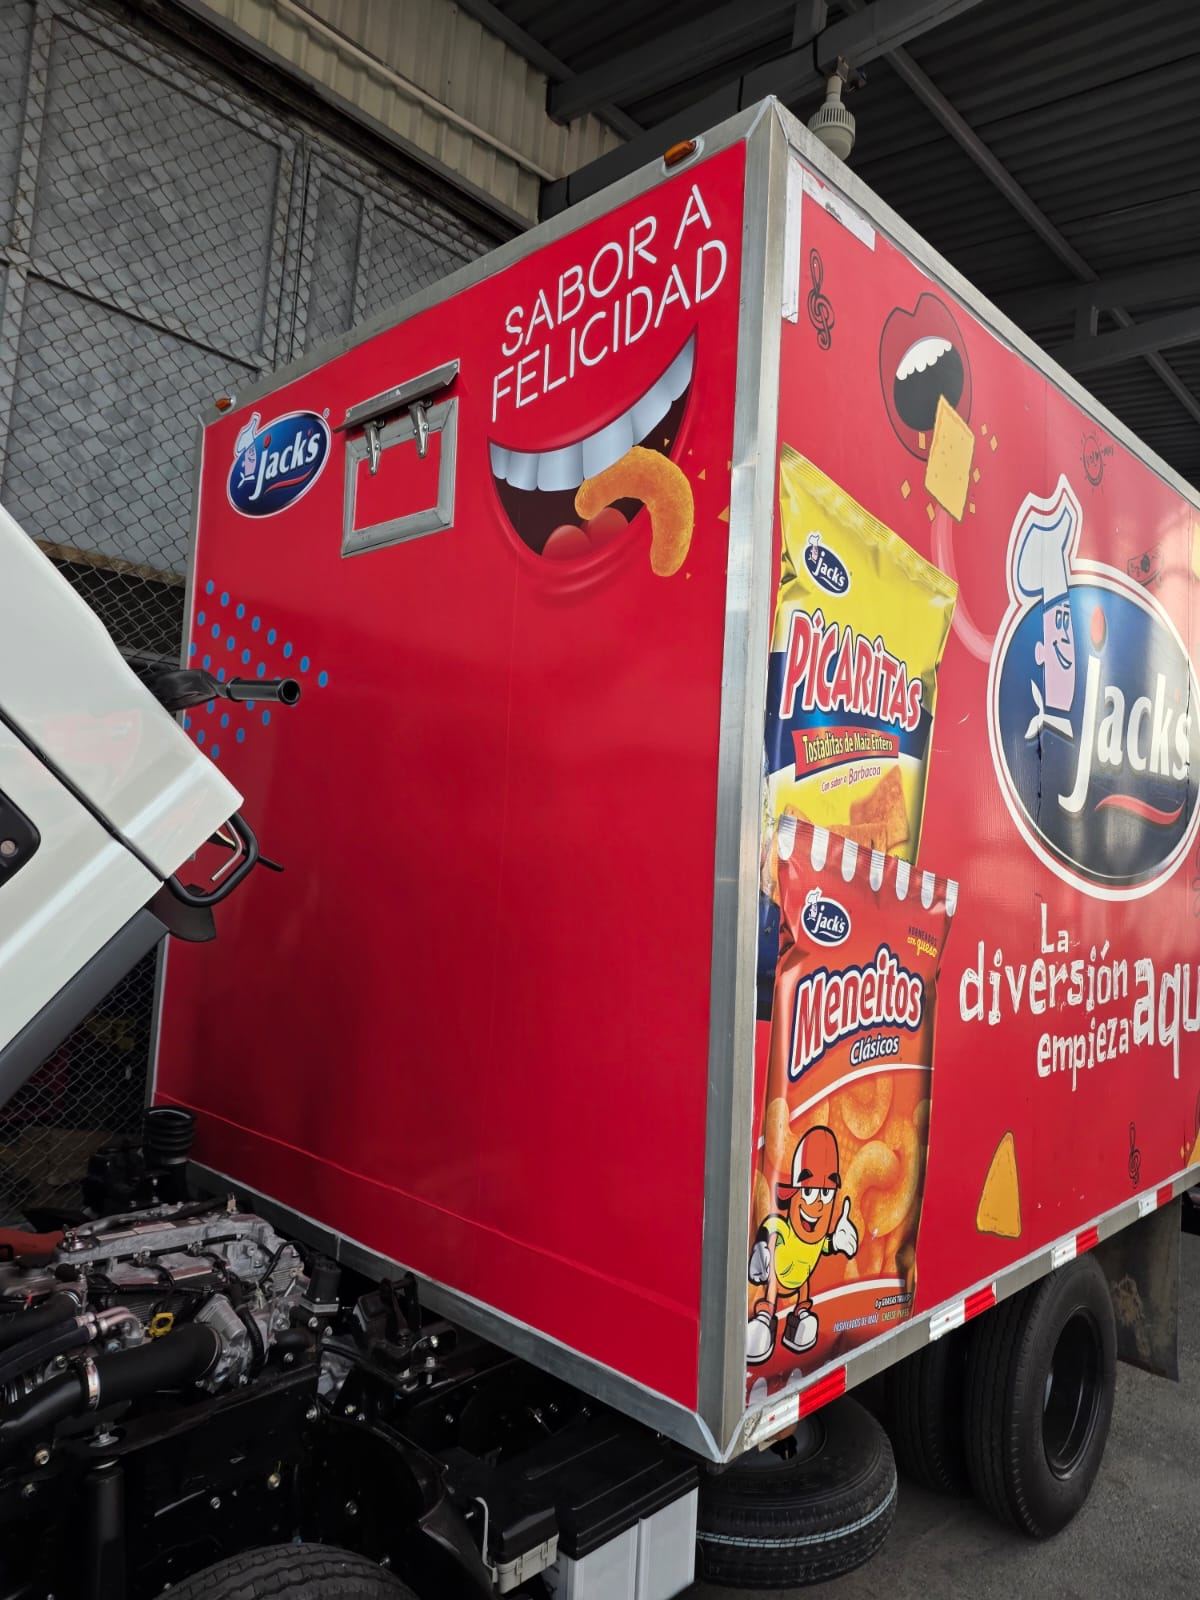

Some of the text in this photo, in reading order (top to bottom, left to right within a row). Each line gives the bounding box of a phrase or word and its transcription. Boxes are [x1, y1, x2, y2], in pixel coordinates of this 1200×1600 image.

[502, 184, 712, 356] SABOR A
[492, 240, 727, 423] FELICIDAD
[802, 731, 843, 764] Tostaditas
[844, 731, 854, 752] de
[871, 734, 893, 751] Entero
[848, 766, 881, 785] Barbacoa
[1040, 903, 1069, 953] La
[789, 945, 924, 1080] Meneitos
[959, 939, 1128, 1026] diversión
[850, 1033, 899, 1064] Clásicos
[1037, 1017, 1129, 1092] empieza
